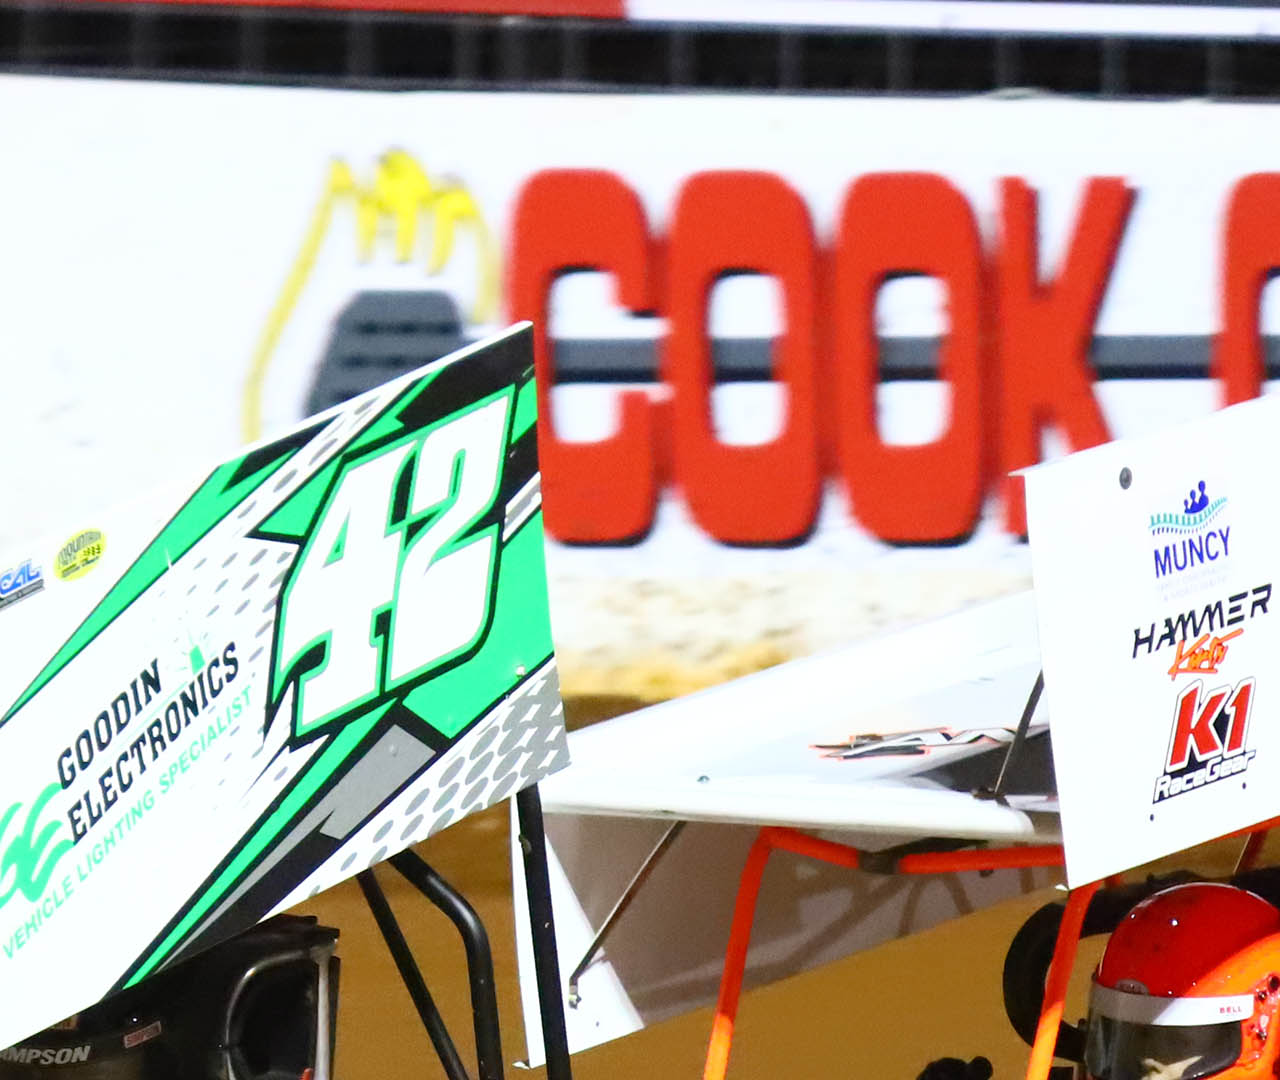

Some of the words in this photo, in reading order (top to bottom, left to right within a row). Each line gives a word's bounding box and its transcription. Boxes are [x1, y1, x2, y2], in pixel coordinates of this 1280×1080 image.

[505, 167, 1142, 548] COOK
[272, 383, 516, 737] 42
[1154, 525, 1230, 578] MUNCY
[1132, 583, 1272, 659] HAMMER
[57, 657, 163, 790] GOODIN
[67, 641, 239, 846] ELECTRONICS
[1152, 750, 1257, 804] RaceGear
[1165, 677, 1256, 774] K1
[2, 875, 75, 960] VEHICLE
[76, 789, 155, 882] LIGHTING
[158, 685, 252, 795] SPECIALIST
[1220, 1006, 1243, 1014] BELL
